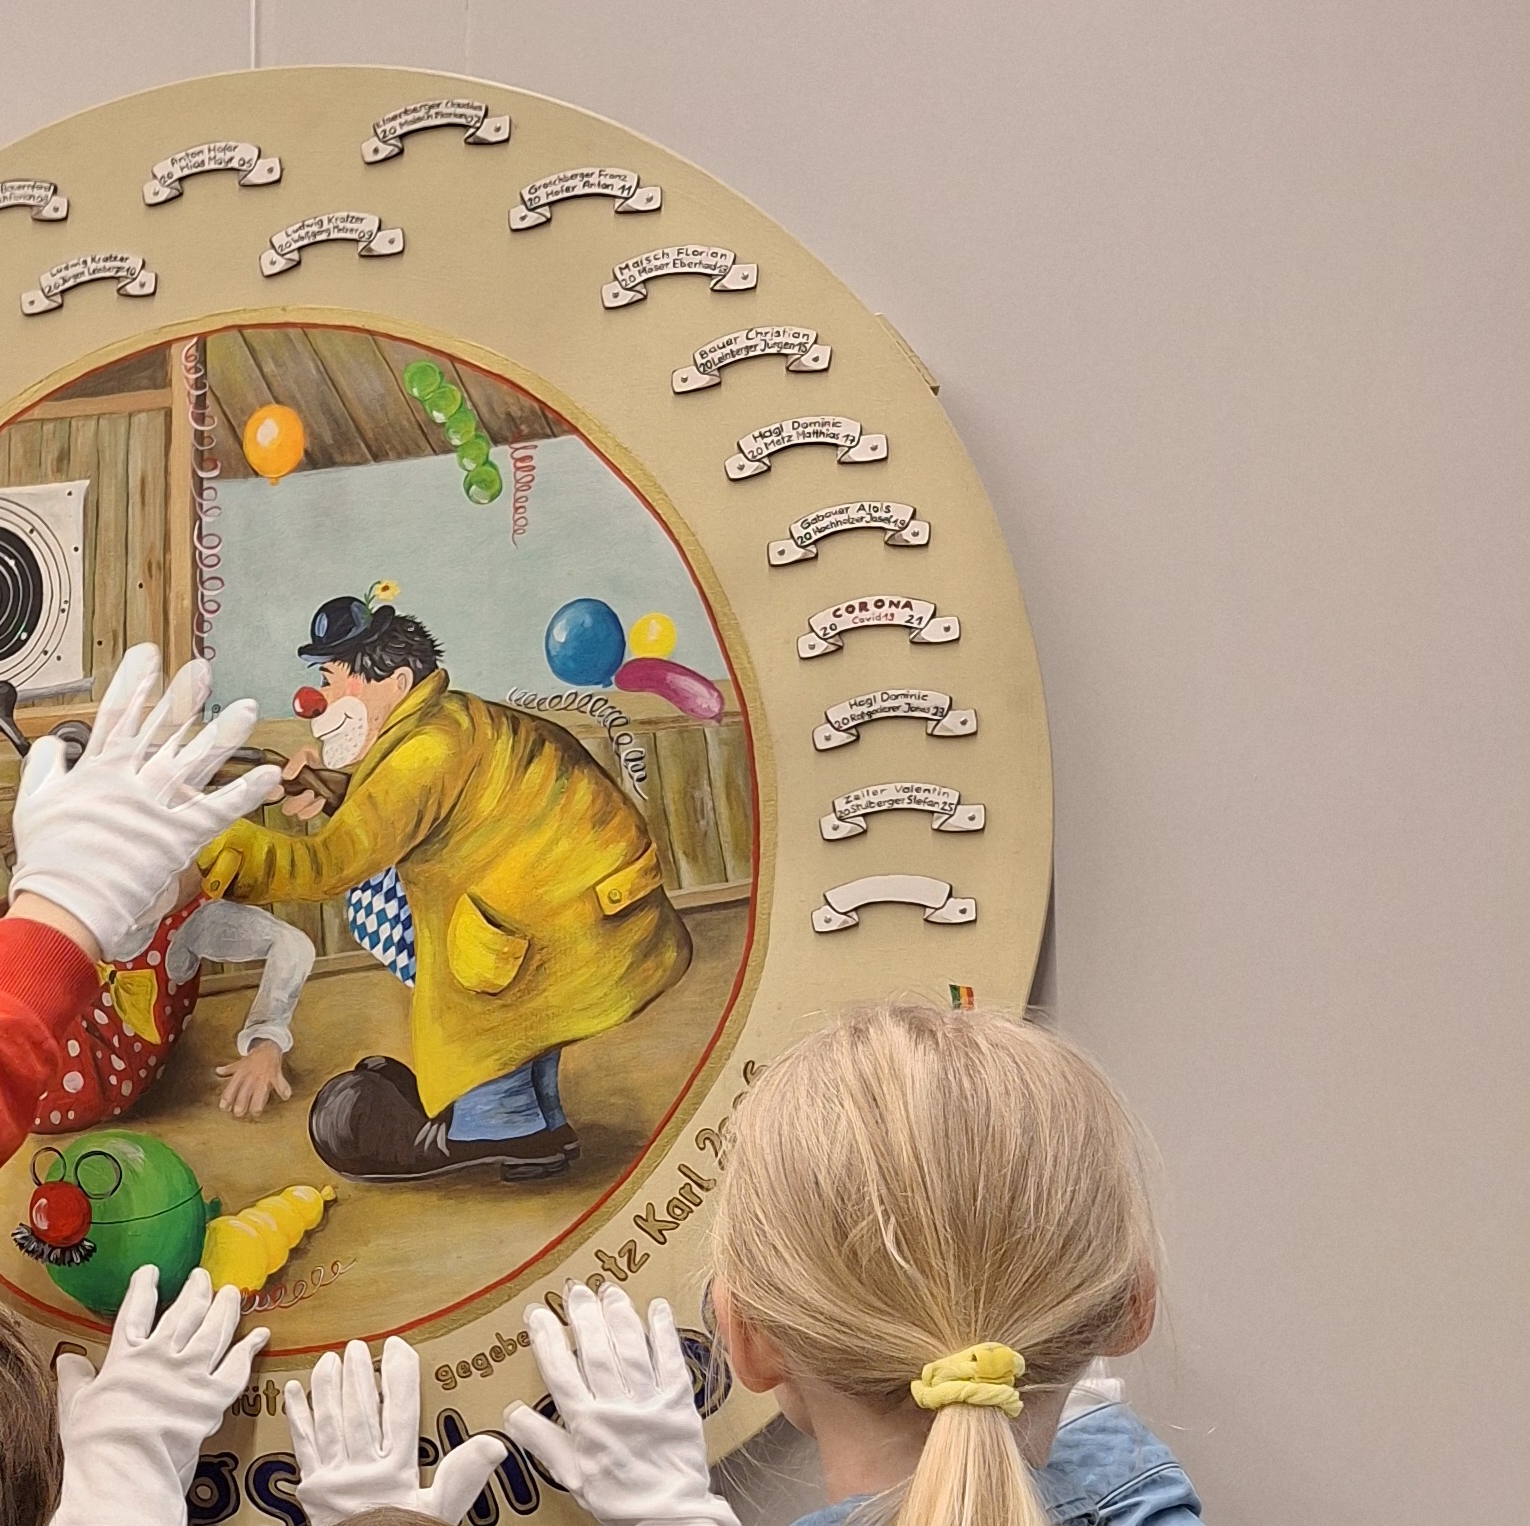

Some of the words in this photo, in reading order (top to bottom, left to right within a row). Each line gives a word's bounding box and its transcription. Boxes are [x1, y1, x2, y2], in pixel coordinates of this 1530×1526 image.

[380, 127, 397, 139] 20
[170, 149, 204, 168] Anton
[208, 144, 239, 157] Hofer
[527, 195, 541, 207] 20
[545, 184, 578, 200] Hofer
[582, 180, 614, 192] Anton
[285, 217, 324, 238] Ludwig
[327, 213, 366, 226] Kratzer
[278, 241, 292, 252] 20
[618, 249, 670, 277] Maisch
[676, 248, 727, 261] Florian
[621, 274, 637, 287] 20
[637, 262, 670, 278] Moser
[698, 335, 740, 360] Bauer
[745, 327, 810, 341] Christian
[699, 362, 713, 374] 20
[752, 423, 784, 443] Hagl
[791, 417, 842, 431] Dominic
[747, 446, 764, 459] 20
[764, 434, 794, 451] Metz
[795, 428, 840, 440] Matthias
[797, 531, 812, 545] 20
[832, 598, 913, 618] CORONA
[820, 622, 838, 637] 20
[904, 614, 923, 626] 21
[880, 690, 929, 702] Dominic
[834, 717, 850, 729] 20
[894, 785, 950, 798] Valentin
[838, 808, 850, 819] 20
[907, 795, 940, 809] Stefan
[633, 1163, 717, 1245] Karl
